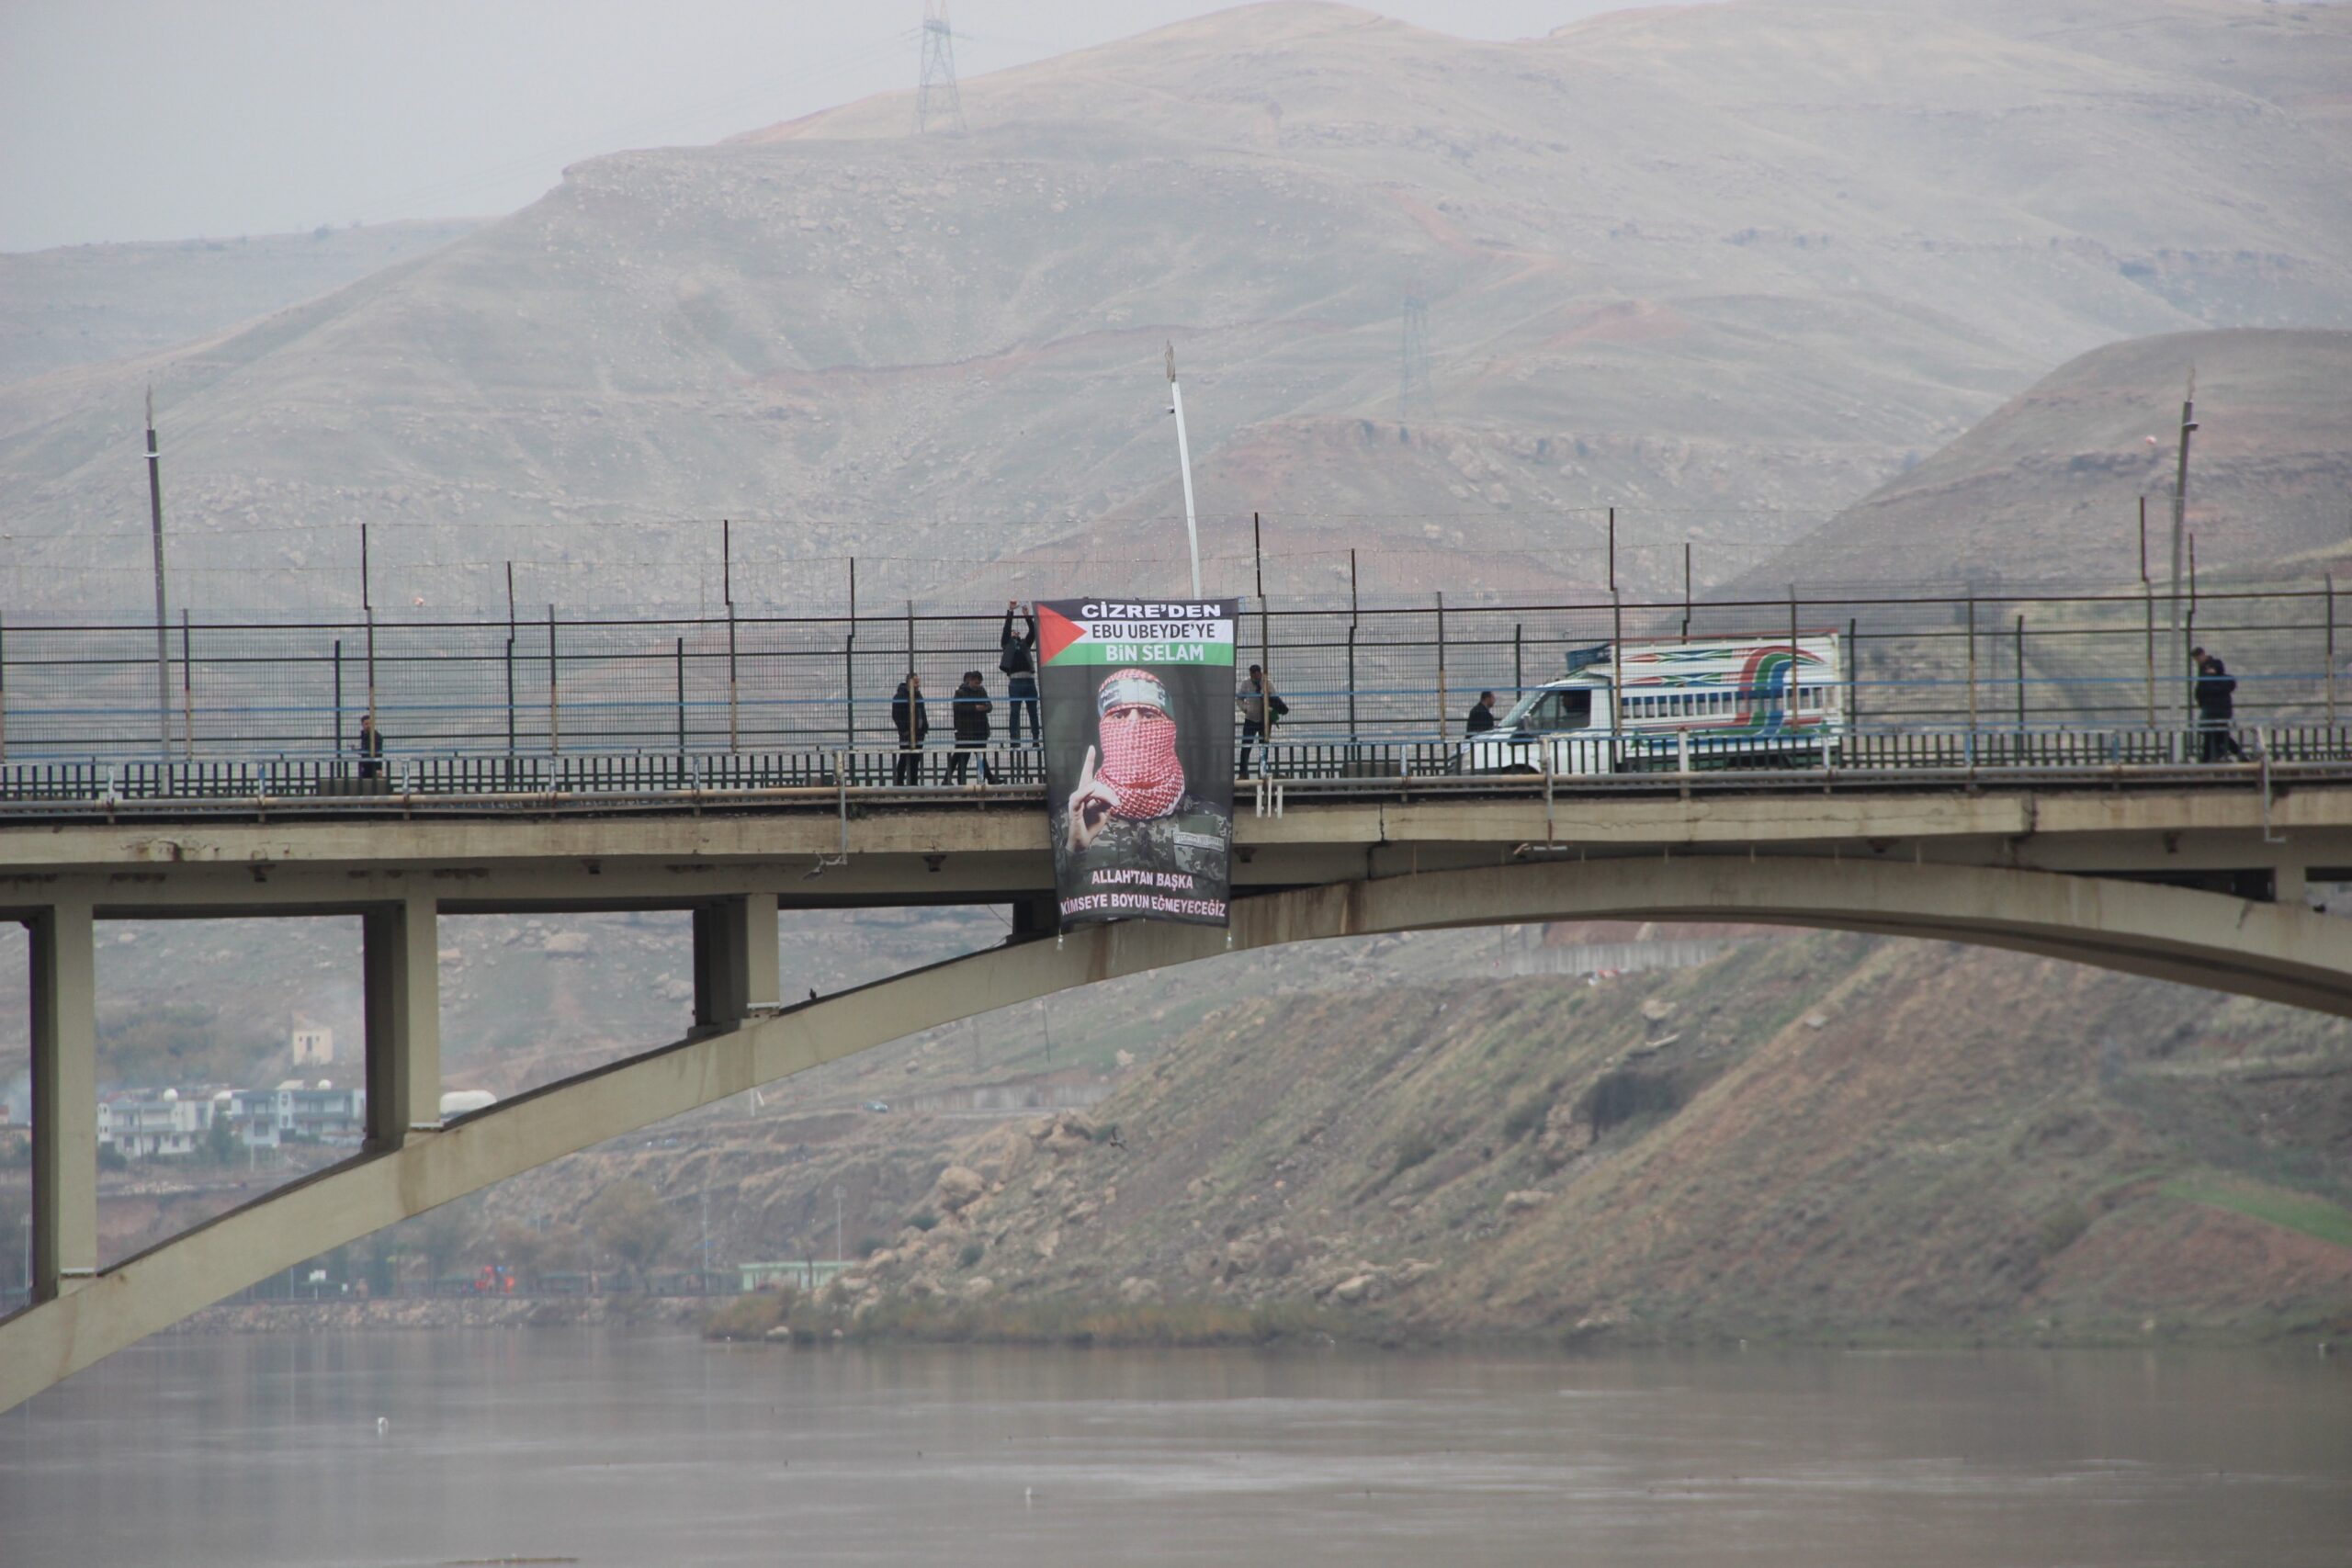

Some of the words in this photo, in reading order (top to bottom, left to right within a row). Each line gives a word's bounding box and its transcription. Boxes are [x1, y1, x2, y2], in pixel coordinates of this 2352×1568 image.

[1081, 601, 1221, 618] CİZRE'DEN
[1092, 624, 1123, 638] EBU
[1128, 623, 1216, 638] UBEYDE'YE
[1142, 644, 1204, 661] SELAM
[1091, 870, 1153, 886] ALLAH'TAN
[1156, 873, 1193, 891] BAŞKA
[1060, 894, 1108, 916] KİMSEYE
[1112, 893, 1149, 909] BOYUN
[1152, 894, 1226, 917] EĞMEYECEĞİZ
